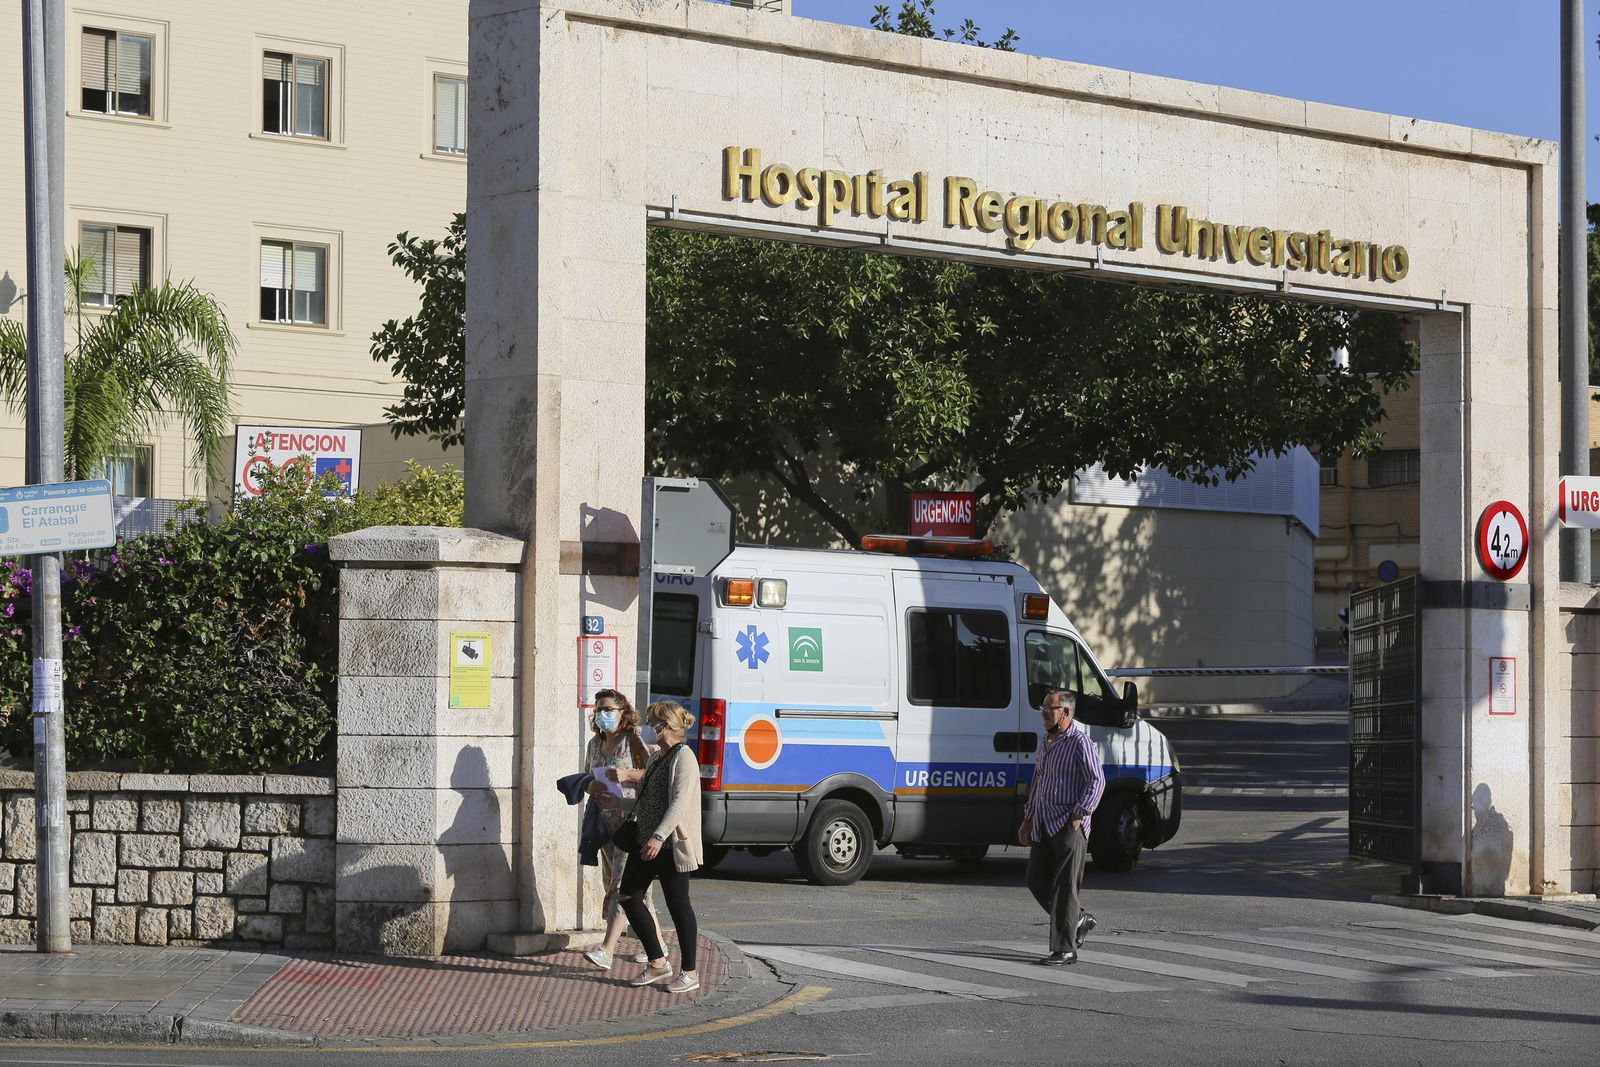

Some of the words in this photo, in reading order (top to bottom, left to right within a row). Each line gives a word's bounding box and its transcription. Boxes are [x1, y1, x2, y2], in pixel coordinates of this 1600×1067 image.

[722, 146, 929, 225] Hospital
[944, 176, 1143, 252] Regional
[1156, 204, 1409, 282] Universitario
[254, 432, 346, 452] ATENCION
[22, 503, 87, 516] Carranque
[1571, 491, 1600, 512] URG
[914, 499, 971, 523] URGENCIAS
[23, 518, 34, 528] El
[39, 515, 78, 527] Atabal
[586, 618, 600, 632] 32
[905, 770, 1006, 787] URGENCIAS
